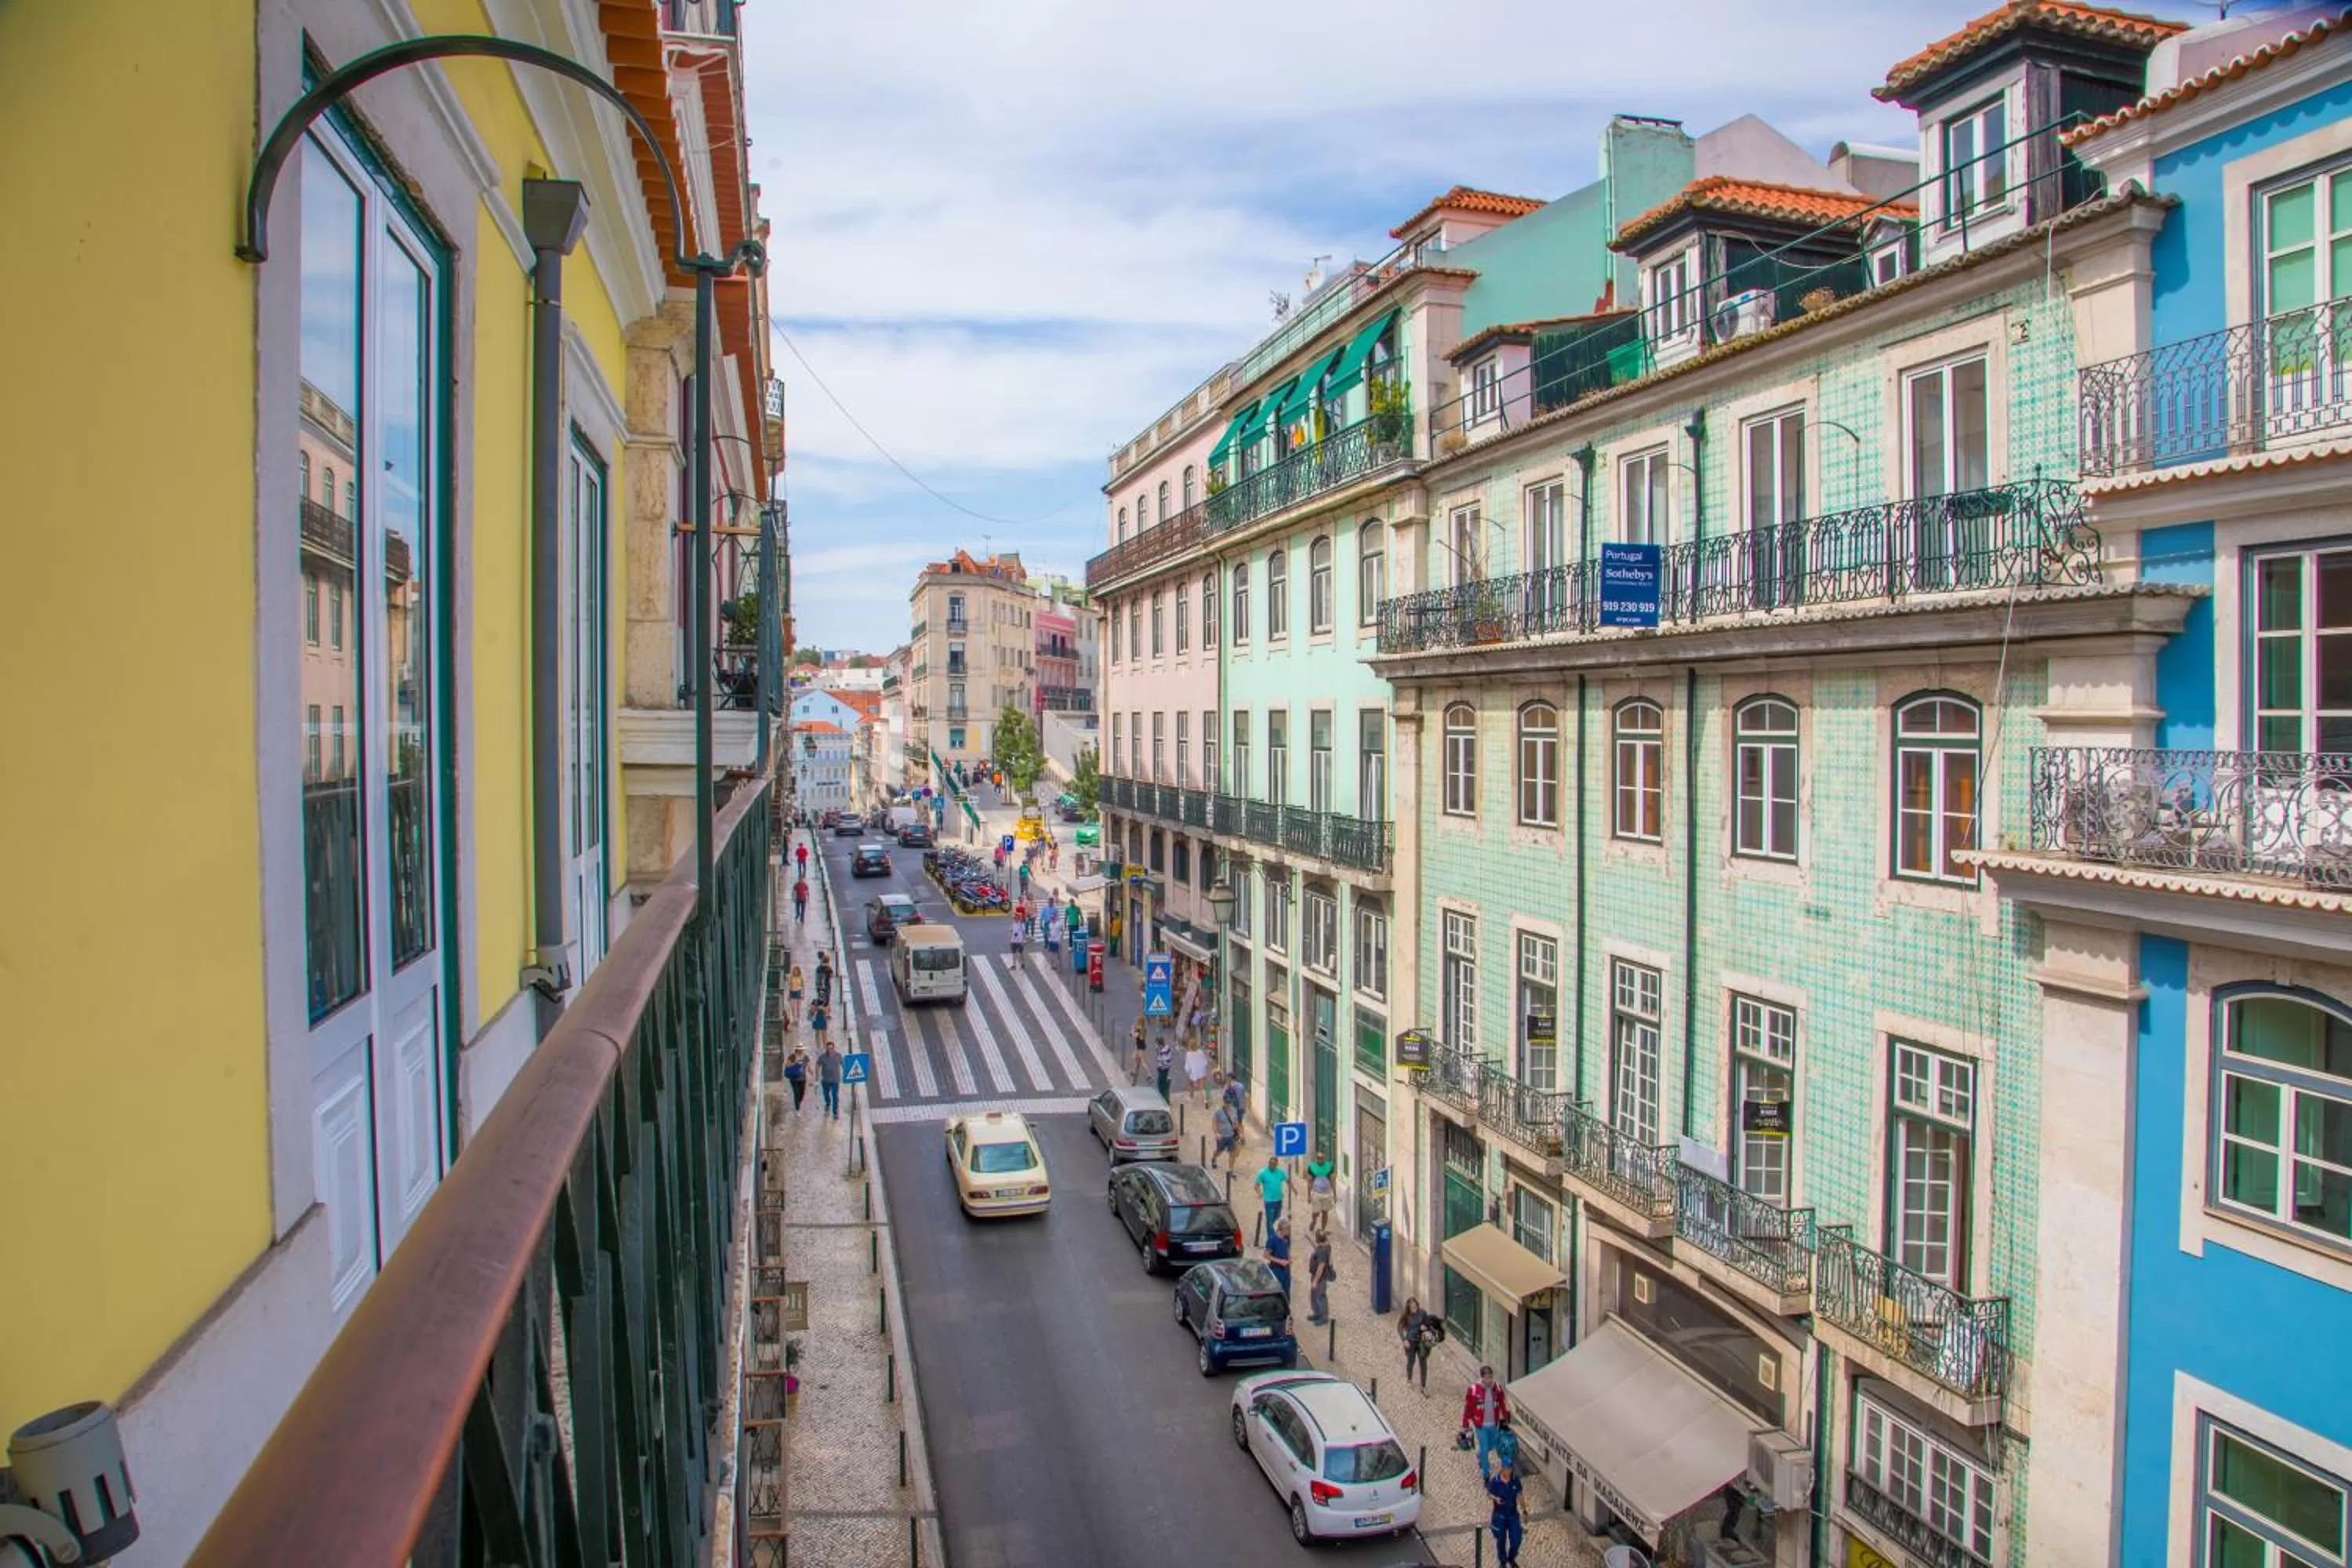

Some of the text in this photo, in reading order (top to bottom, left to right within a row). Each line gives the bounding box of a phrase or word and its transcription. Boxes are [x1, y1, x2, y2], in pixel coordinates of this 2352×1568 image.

[1605, 550, 1643, 561] Portugal
[1605, 568, 1653, 580] Sotheby's
[1602, 601, 1655, 612] 919 230 919
[1004, 837, 1012, 851] P
[1282, 1127, 1300, 1153] P
